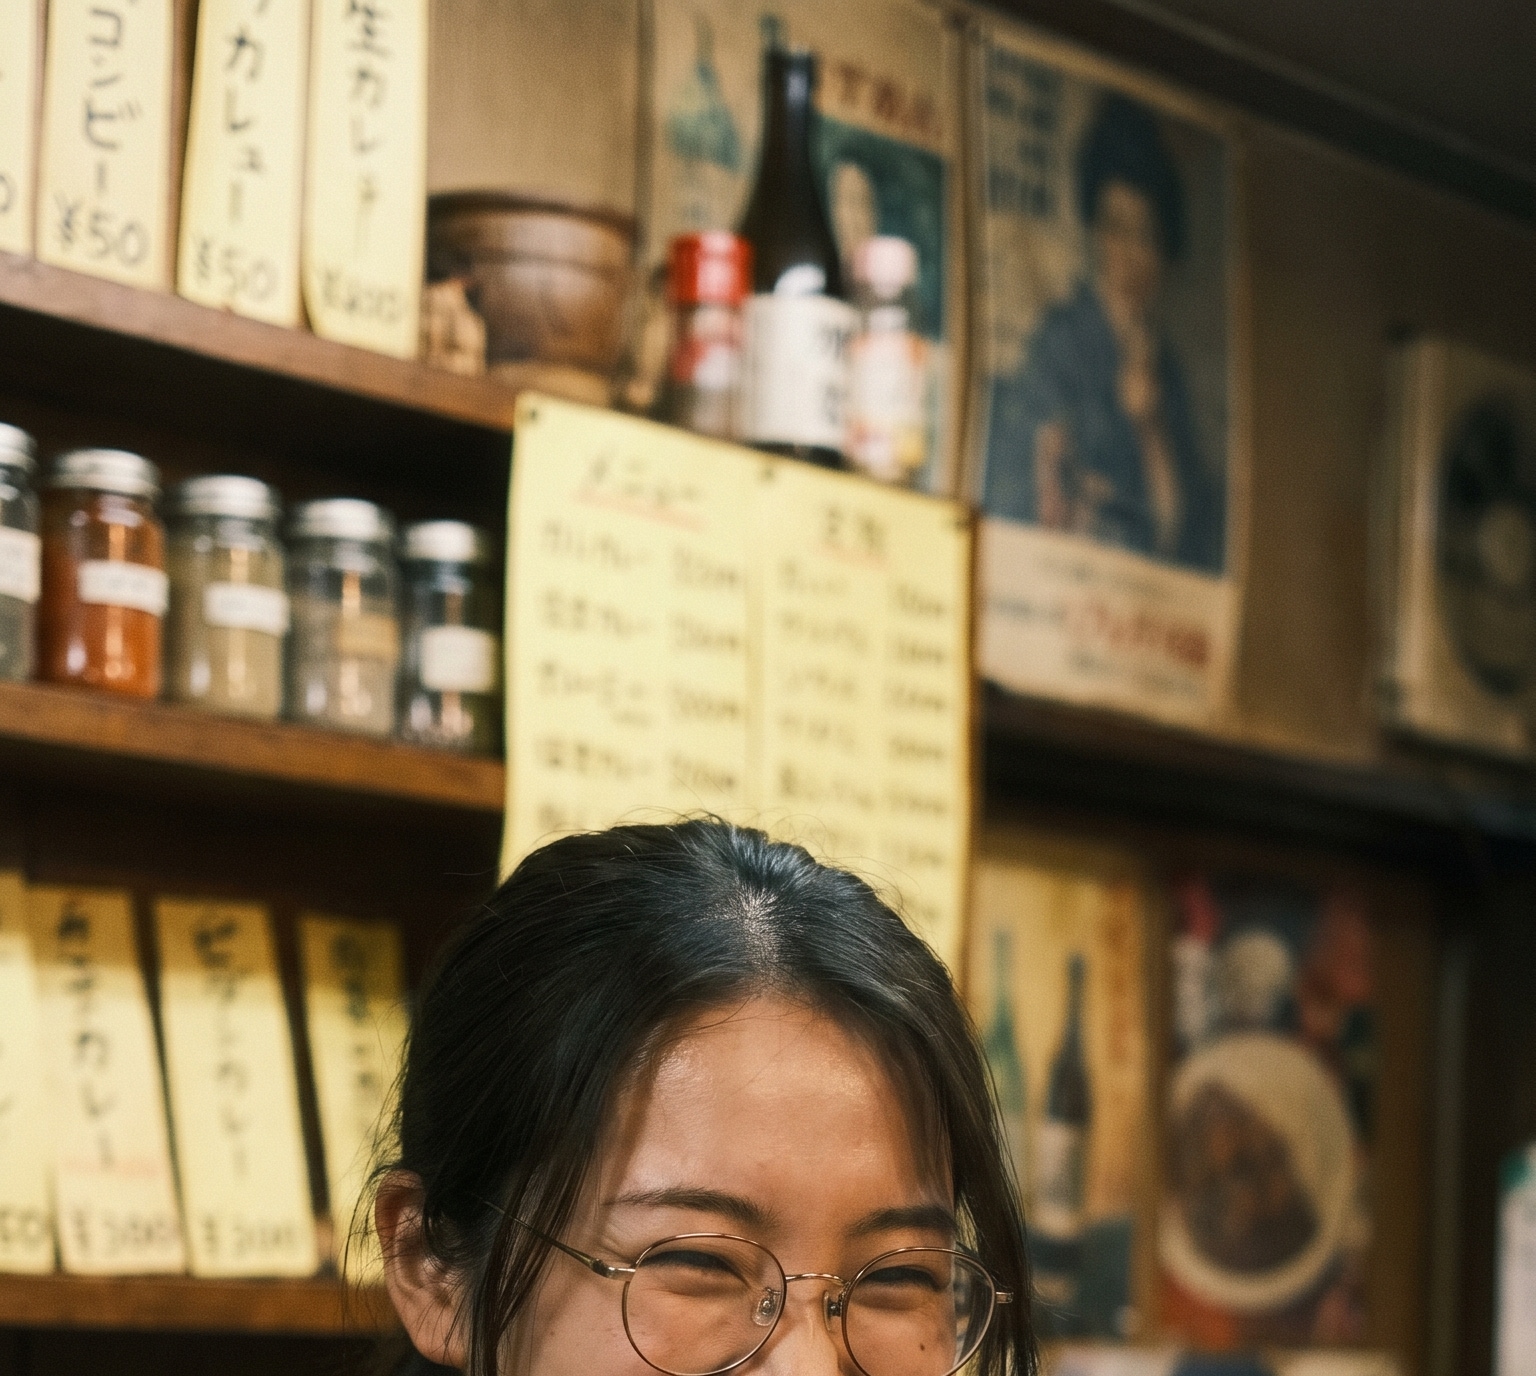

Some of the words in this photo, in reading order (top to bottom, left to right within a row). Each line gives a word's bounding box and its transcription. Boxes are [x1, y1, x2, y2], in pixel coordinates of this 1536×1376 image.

[84, 0, 142, 192] コンビー
[55, 196, 149, 267] ¥50
[195, 234, 281, 300] ¥50
